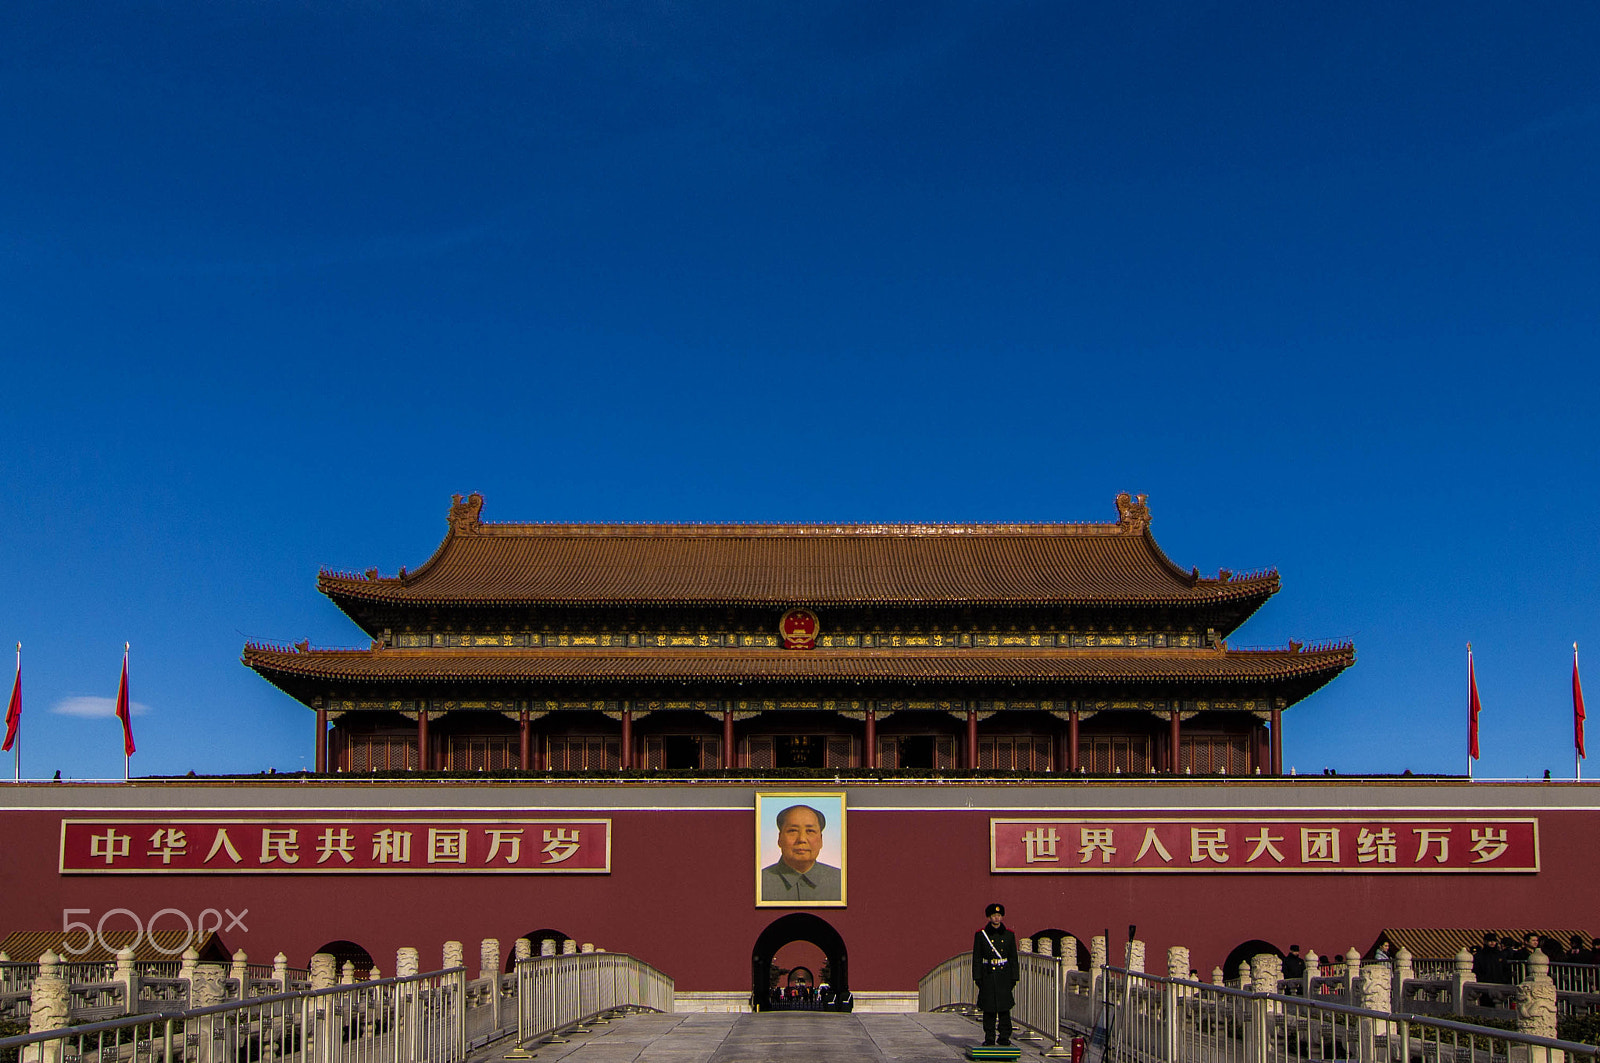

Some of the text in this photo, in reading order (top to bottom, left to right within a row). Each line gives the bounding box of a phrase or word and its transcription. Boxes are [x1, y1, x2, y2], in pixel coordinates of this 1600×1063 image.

[90, 828, 582, 864] 中华人民共和国万岁
[1021, 827, 1510, 863] 世界人民大团结万岁
